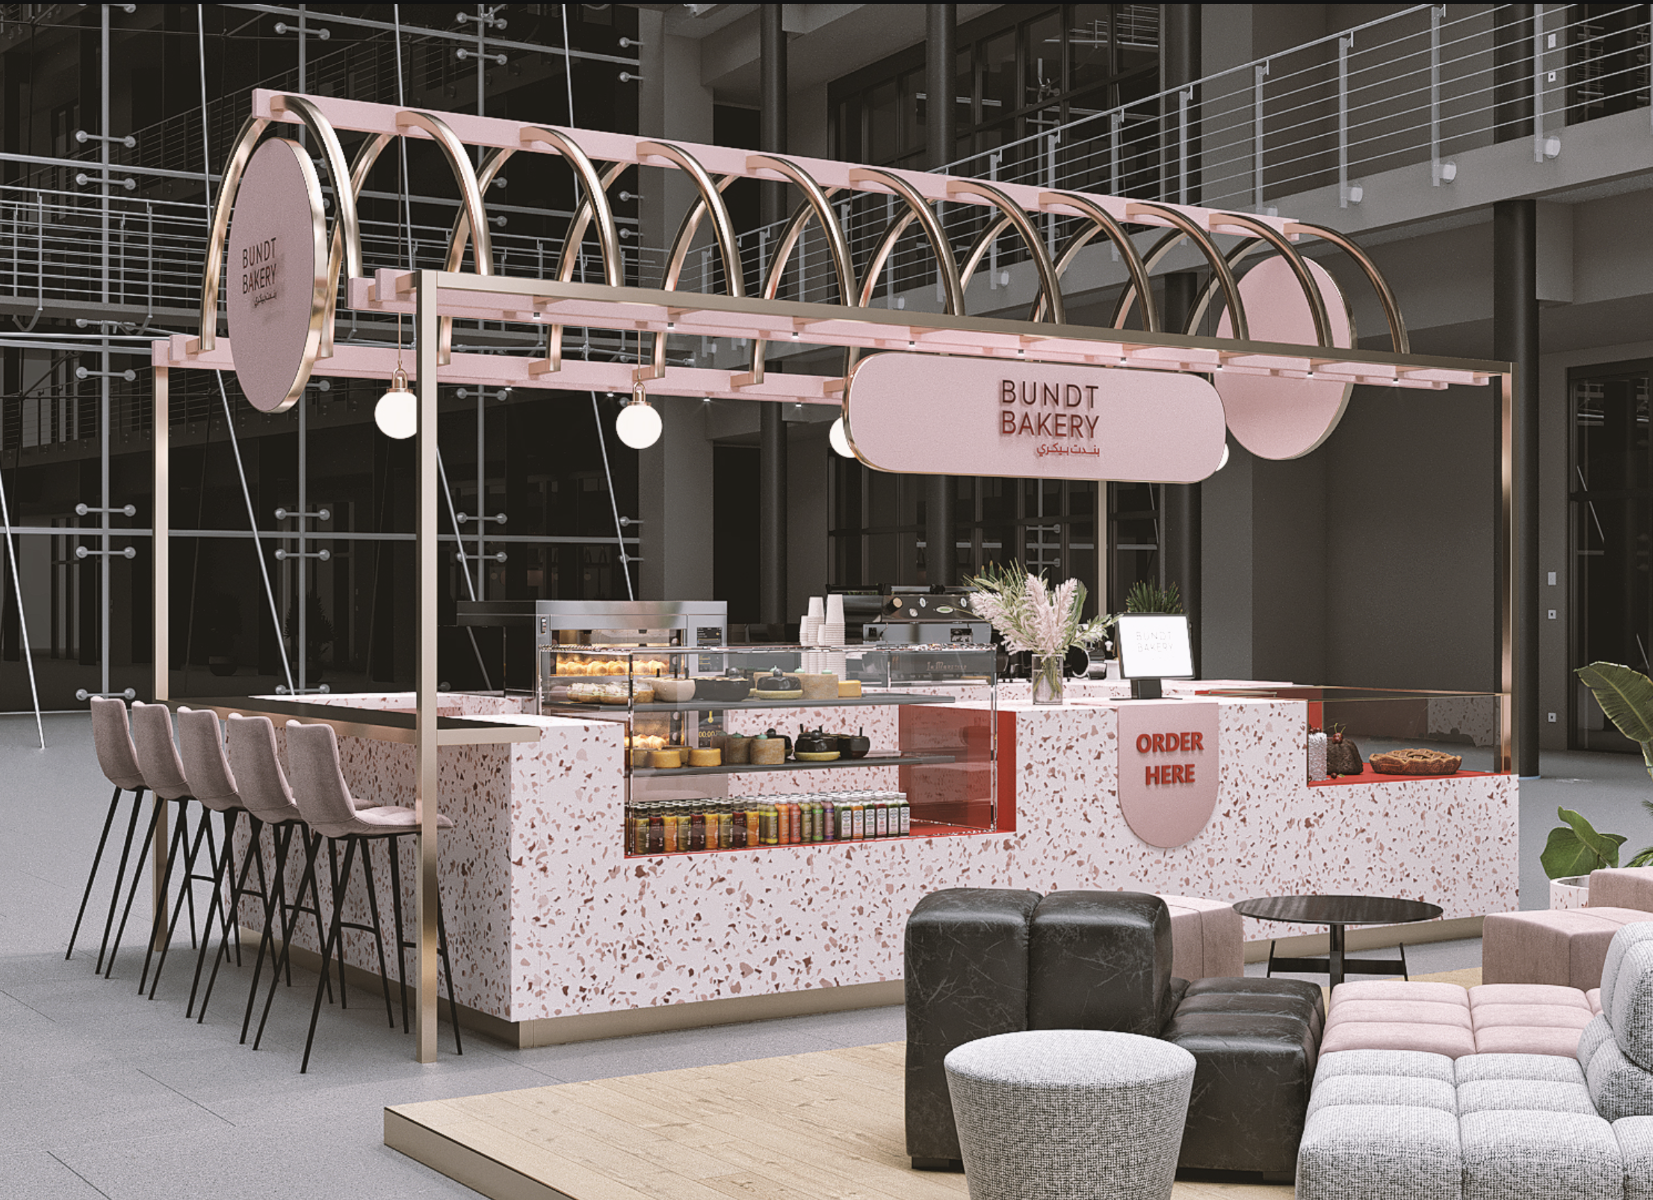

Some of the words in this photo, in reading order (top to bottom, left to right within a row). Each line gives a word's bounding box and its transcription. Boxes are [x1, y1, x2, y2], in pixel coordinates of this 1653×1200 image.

[243, 237, 276, 269] BUNDT
[243, 263, 276, 294] BAKERY
[1002, 379, 1099, 409] BUNDT
[1002, 410, 1100, 439] BAKERY
[1136, 631, 1171, 641] BUNDT
[1136, 642, 1173, 652] BAKERY
[1136, 732, 1204, 753] ORDER
[1145, 764, 1196, 785] HERE
